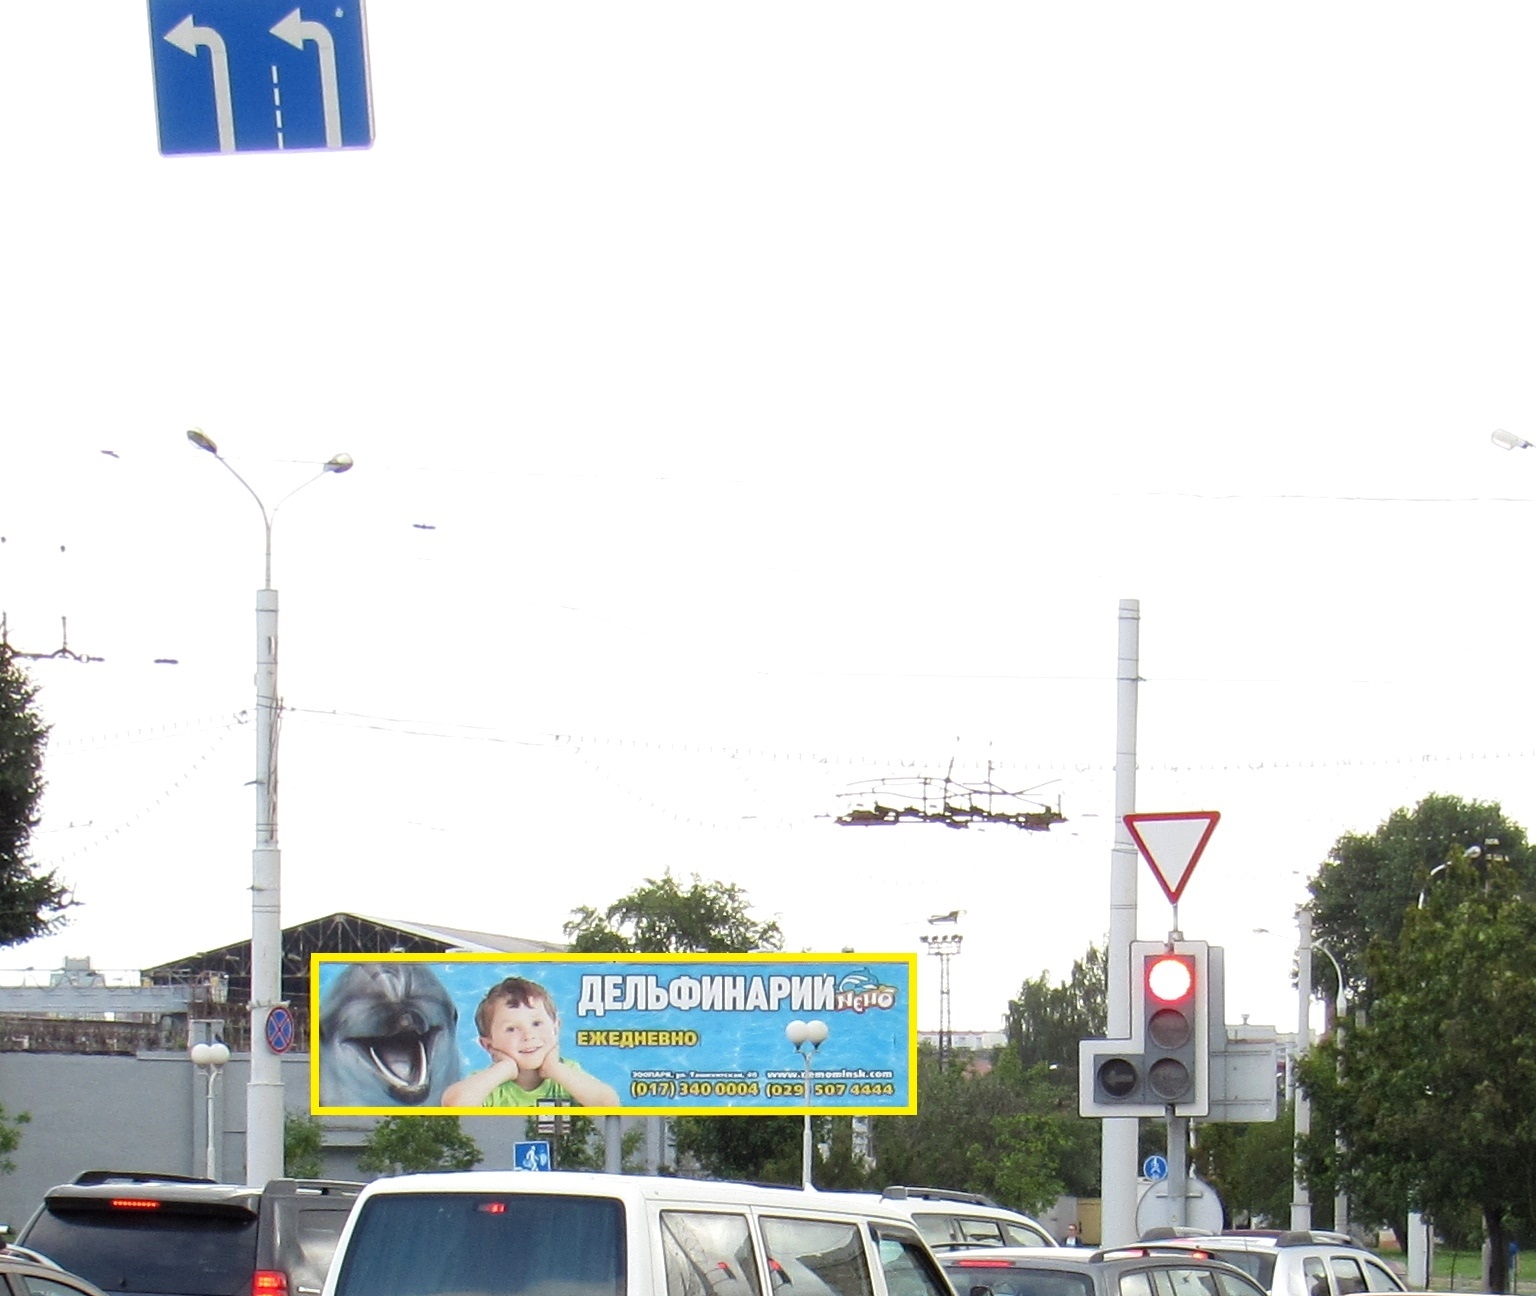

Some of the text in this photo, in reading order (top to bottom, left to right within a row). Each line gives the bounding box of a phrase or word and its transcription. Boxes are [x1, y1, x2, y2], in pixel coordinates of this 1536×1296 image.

[577, 972, 835, 1017] ДЕЛЬФИНАРИЙ
[576, 1030, 699, 1048] ЕЖЕДНЕВНО
[630, 1081, 760, 1099] (017) 340 0004
[766, 1082, 895, 1099] (029 507 4444
